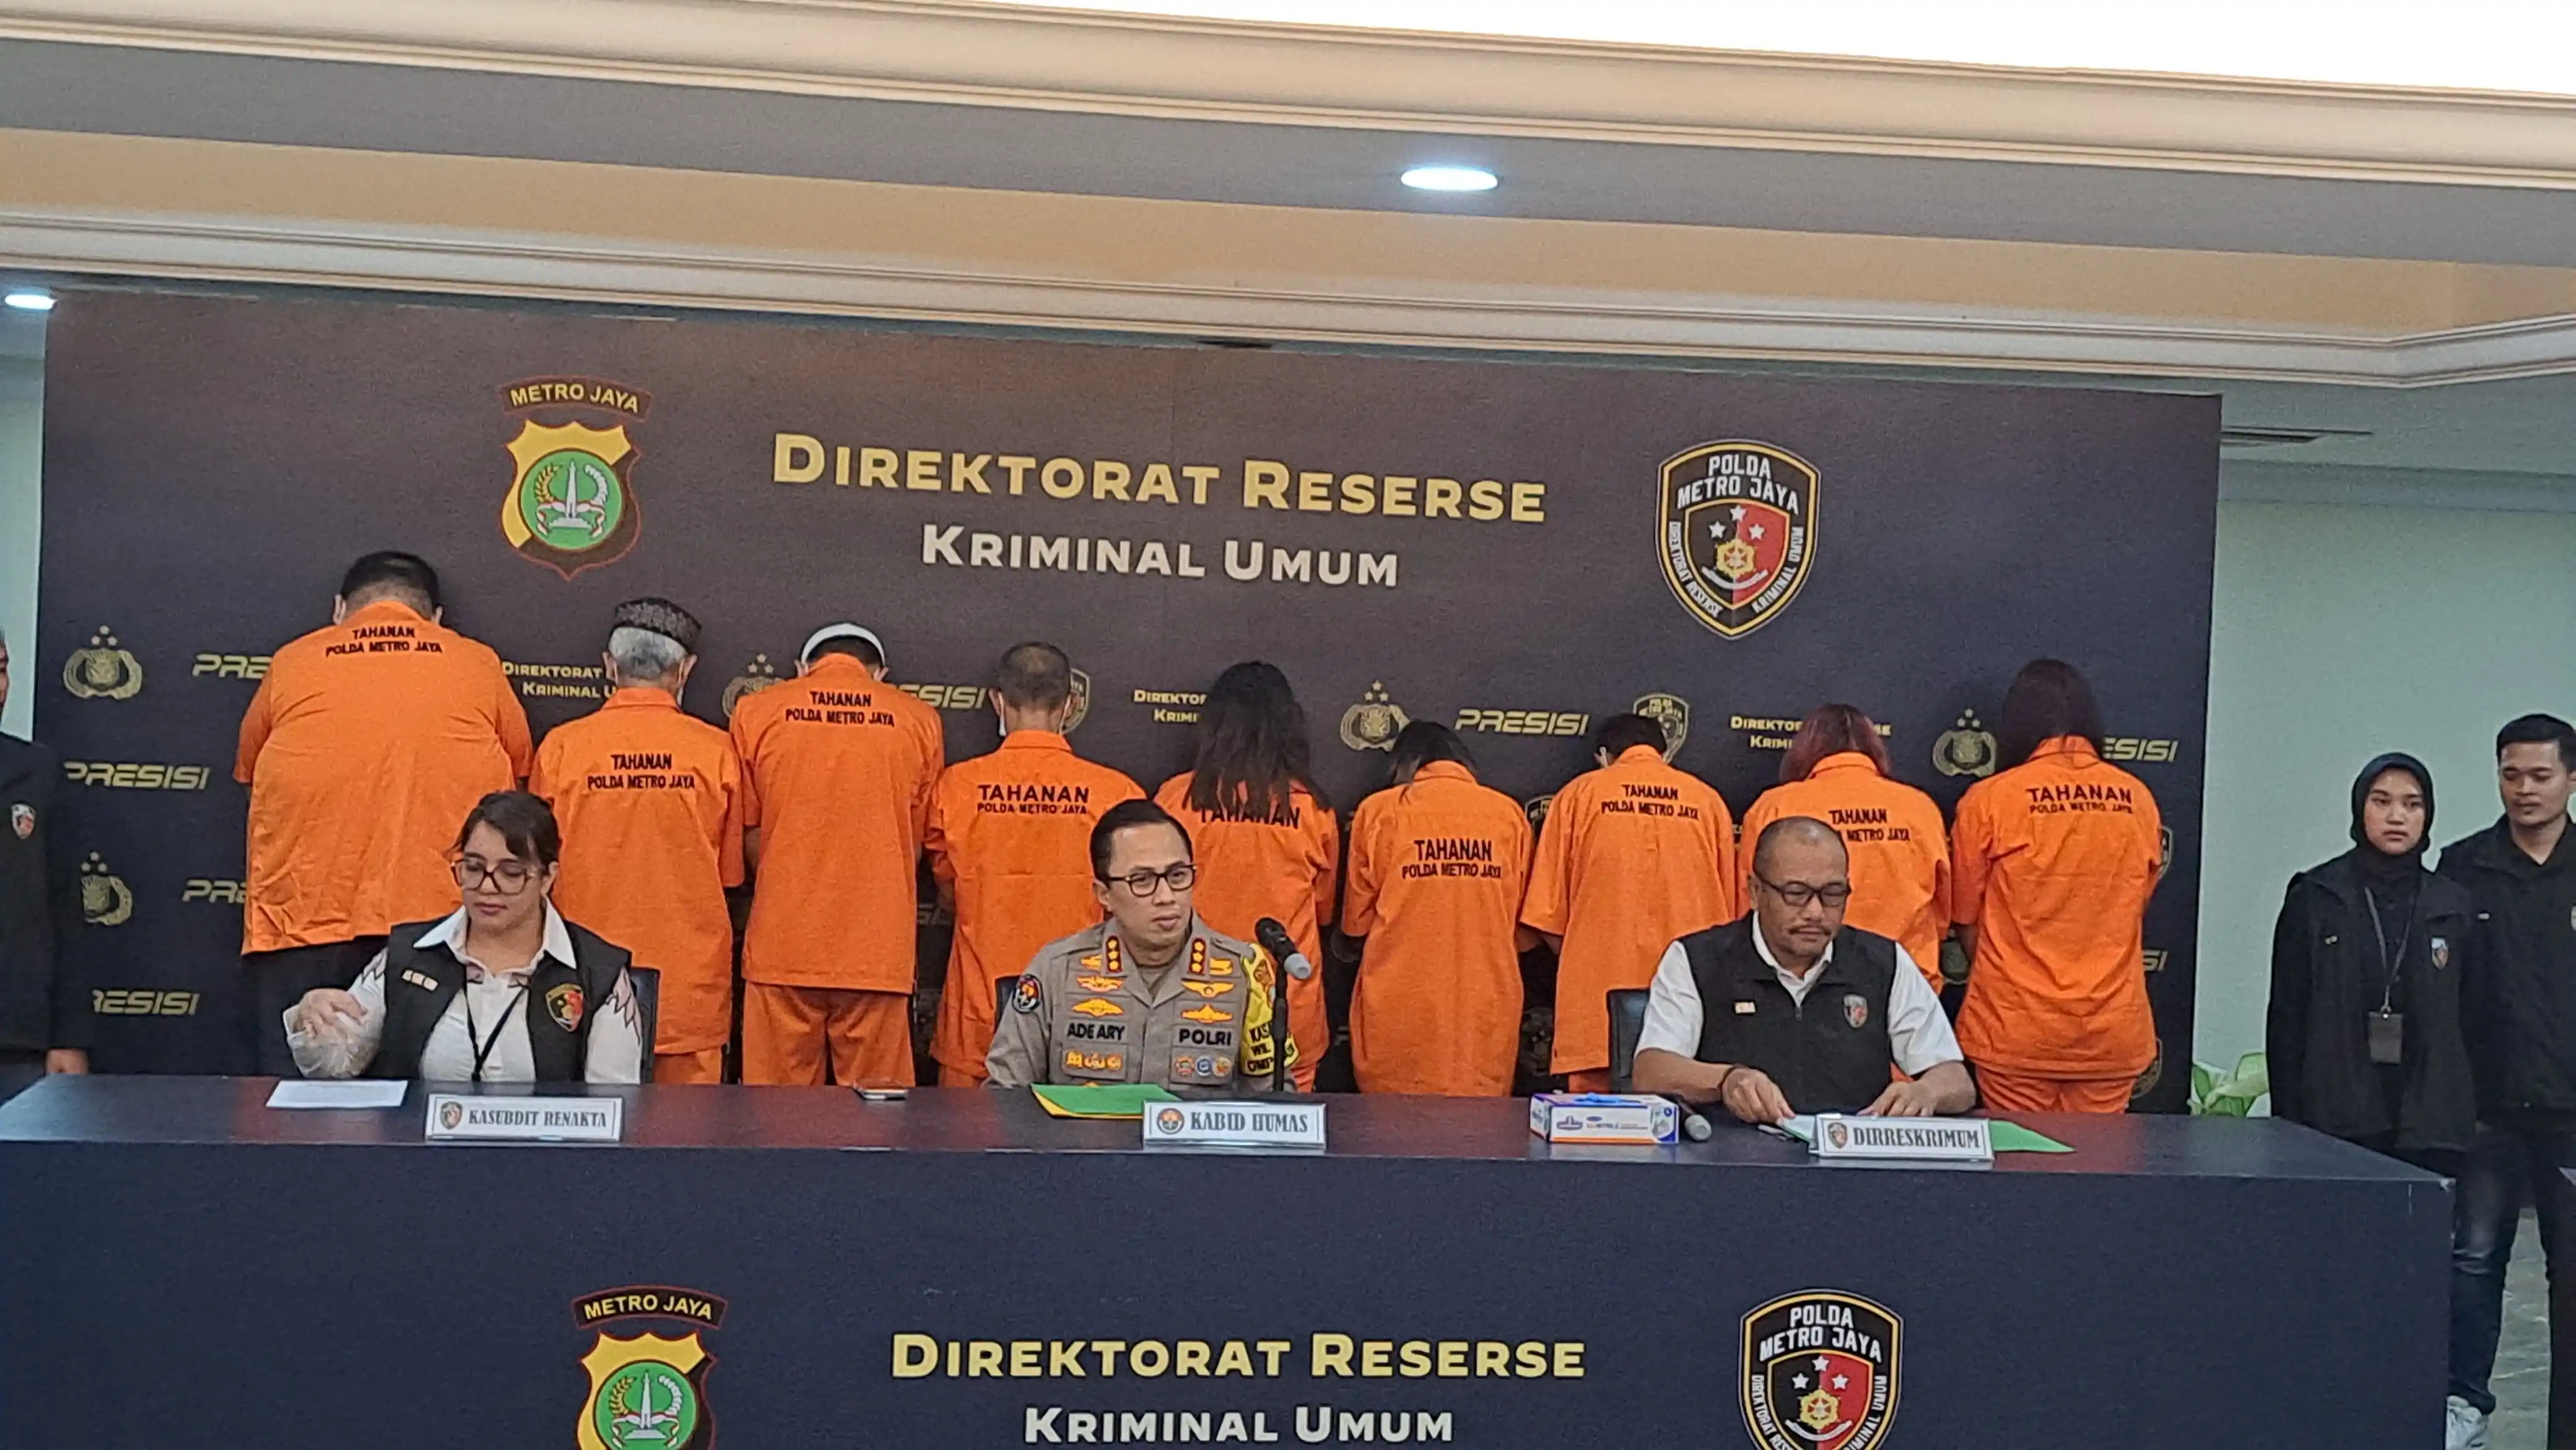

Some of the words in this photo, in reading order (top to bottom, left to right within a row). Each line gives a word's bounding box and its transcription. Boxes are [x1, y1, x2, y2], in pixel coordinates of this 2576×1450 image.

[510, 383, 585, 407] METRO
[590, 385, 638, 414] JAYA
[1708, 454, 1771, 479] POLDA
[773, 433, 1220, 505] DIREKTORAT
[1243, 459, 1546, 522] RESERSE
[1677, 475, 1741, 509] METRO
[1749, 477, 1799, 515] JAYA
[922, 524, 1206, 577] KRIMINAL
[1224, 540, 1398, 586] UMUM
[352, 625, 416, 640] TAHANAN
[325, 641, 364, 658] POLDA
[369, 641, 410, 653] METRO
[414, 641, 443, 653] JAYA
[502, 661, 603, 679] DIREKTORAT
[523, 682, 601, 698] KRIMINAL
[810, 691, 872, 707] TAHANAN
[785, 708, 822, 722] POLDA
[827, 711, 864, 725] METRO
[868, 711, 895, 727] JAYA
[1455, 708, 1589, 736] PRESISI
[611, 753, 672, 770] TAHANAN
[588, 775, 624, 791] POLDA
[627, 774, 666, 789] METRO
[669, 775, 695, 789] JAYA
[977, 784, 1089, 803] TAHANAN
[1621, 784, 1679, 801] TAHANAN
[2025, 784, 2131, 803] TAHANAN
[977, 802, 1015, 814] POLDA
[1019, 804, 1057, 814] METRO
[1061, 804, 1087, 814] JAYA
[1601, 800, 1635, 814] POLDA
[1638, 801, 1674, 816] METRO
[1828, 808, 1887, 825] TAHANAN
[2029, 803, 2066, 814] POLDA
[1847, 828, 1884, 842] METRO
[1414, 838, 1492, 862] TAHANAN
[1402, 862, 1438, 879] POLDA
[1441, 862, 1479, 877] METRO
[1067, 1023, 1097, 1040] ADE
[1098, 1023, 1125, 1041] ARY
[1179, 1028, 1232, 1046] POLRI
[469, 1109, 539, 1126] KASUBDIT
[544, 1111, 607, 1127] RENAKTA
[1191, 1112, 1245, 1131] KABID
[1252, 1113, 1308, 1132] HUMAS
[1853, 1127, 1980, 1148] DIRRESKRIMUM
[584, 1295, 658, 1319] METRO
[663, 1296, 711, 1320] JAYA
[1790, 1305, 1853, 1328] POLDA
[1759, 1326, 1823, 1362] METRO
[1832, 1327, 1882, 1363] JAYA
[892, 1333, 1290, 1378] DIREKTORAT
[1310, 1333, 1585, 1378] RESERSE
[1871, 1375, 1887, 1411] UMUM
[1025, 1407, 1279, 1443] KRIMINAL
[1295, 1406, 1453, 1443] UMUM
